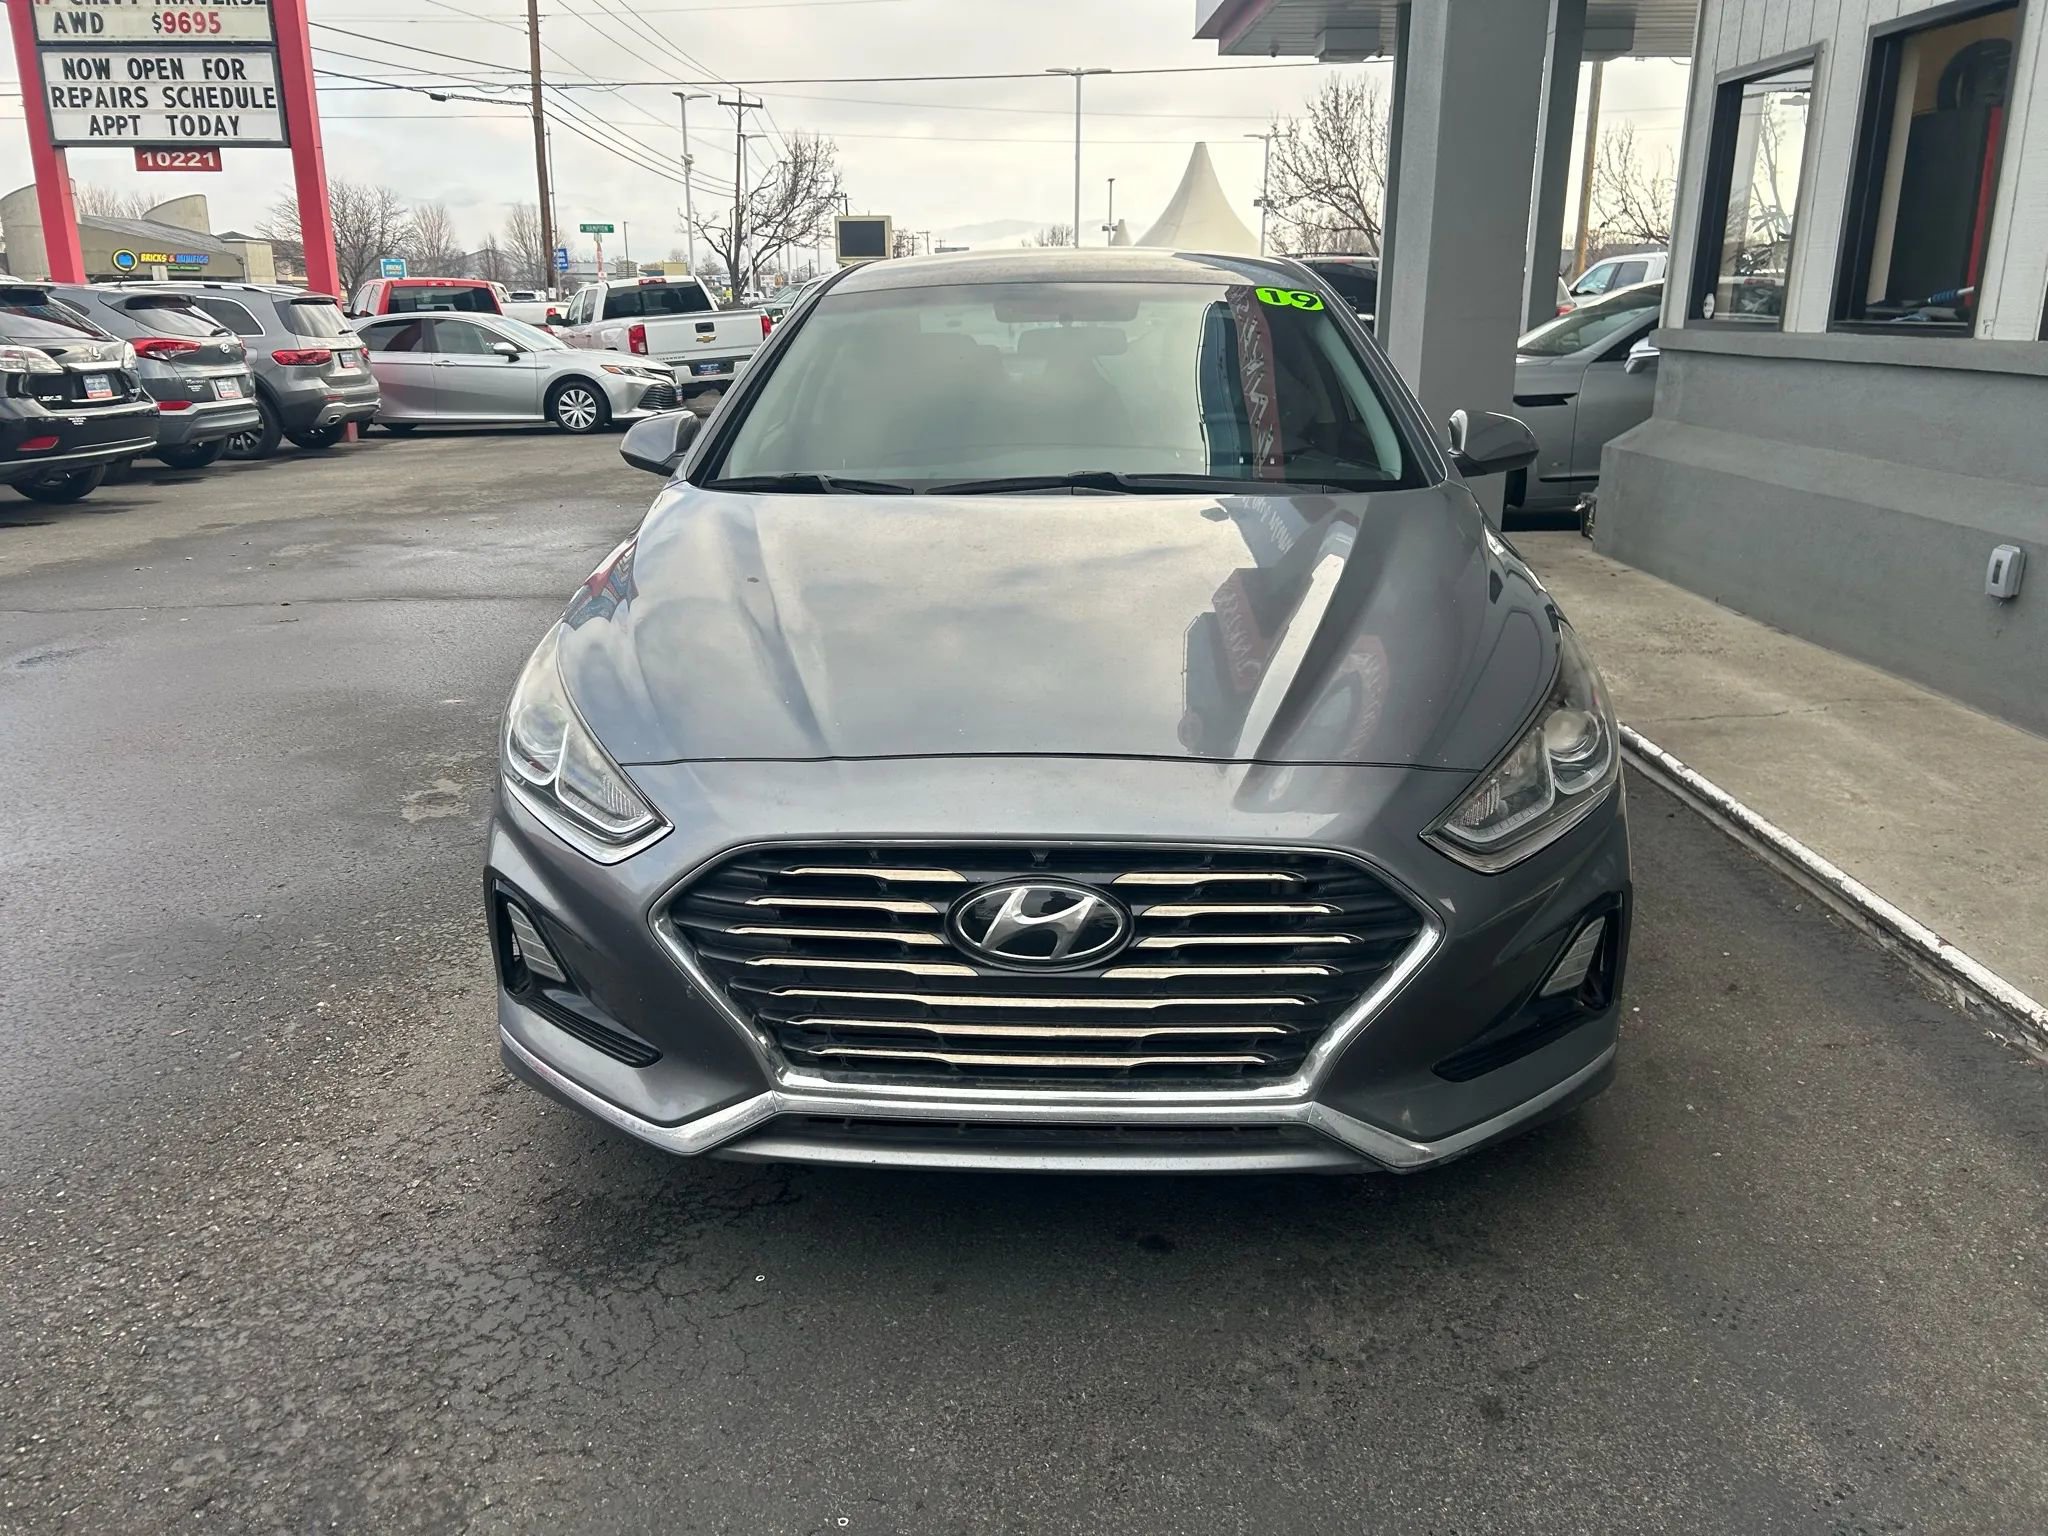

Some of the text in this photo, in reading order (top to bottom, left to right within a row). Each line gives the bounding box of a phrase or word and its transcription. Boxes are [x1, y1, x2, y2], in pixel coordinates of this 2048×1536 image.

[54, 11, 222, 34] AWD $9695
[62, 57, 247, 80] NOW OPEN FOR
[50, 86, 277, 109] REPAIRS SCHEDULE
[89, 114, 240, 136] APPT TODAY
[142, 151, 215, 167] 10221
[140, 252, 168, 264] BRICKS
[1264, 289, 1319, 308] 19
